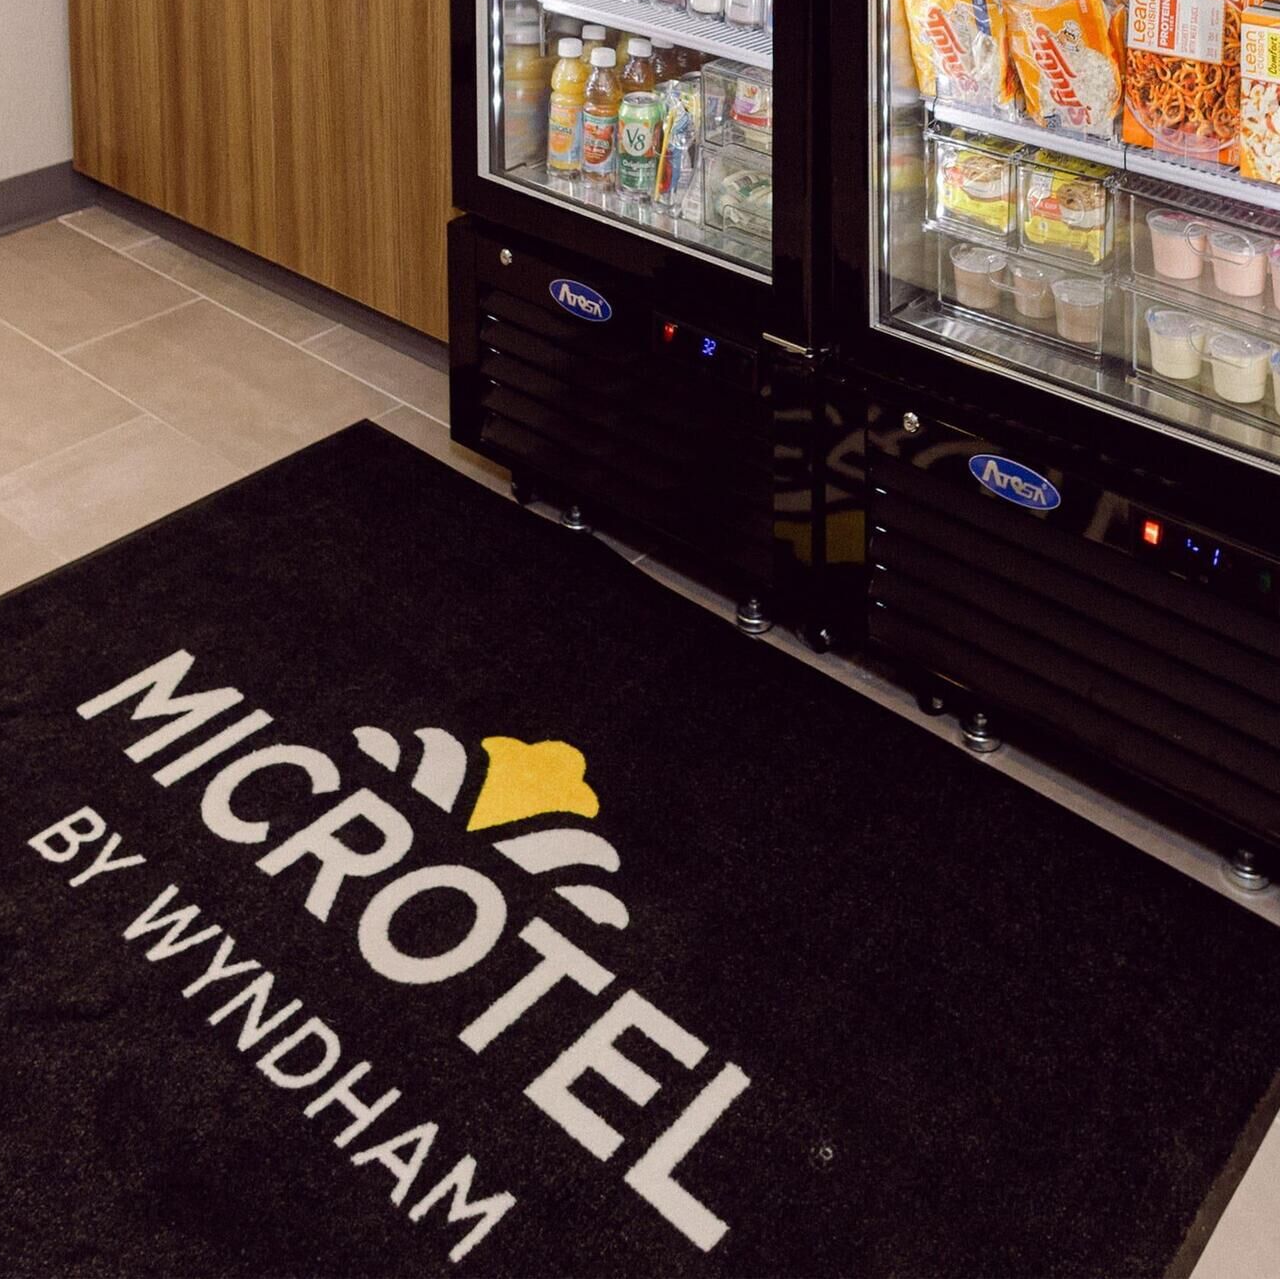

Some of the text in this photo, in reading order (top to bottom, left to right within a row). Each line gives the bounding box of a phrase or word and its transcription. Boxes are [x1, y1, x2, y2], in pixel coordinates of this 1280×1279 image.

[1244, 30, 1257, 74] Lean
[1269, 36, 1278, 75] Comfort
[626, 128, 646, 151] V8
[702, 337, 717, 356] 32
[76, 648, 752, 1254] MICROTEL
[27, 805, 517, 1264] BY WYNDHAM
